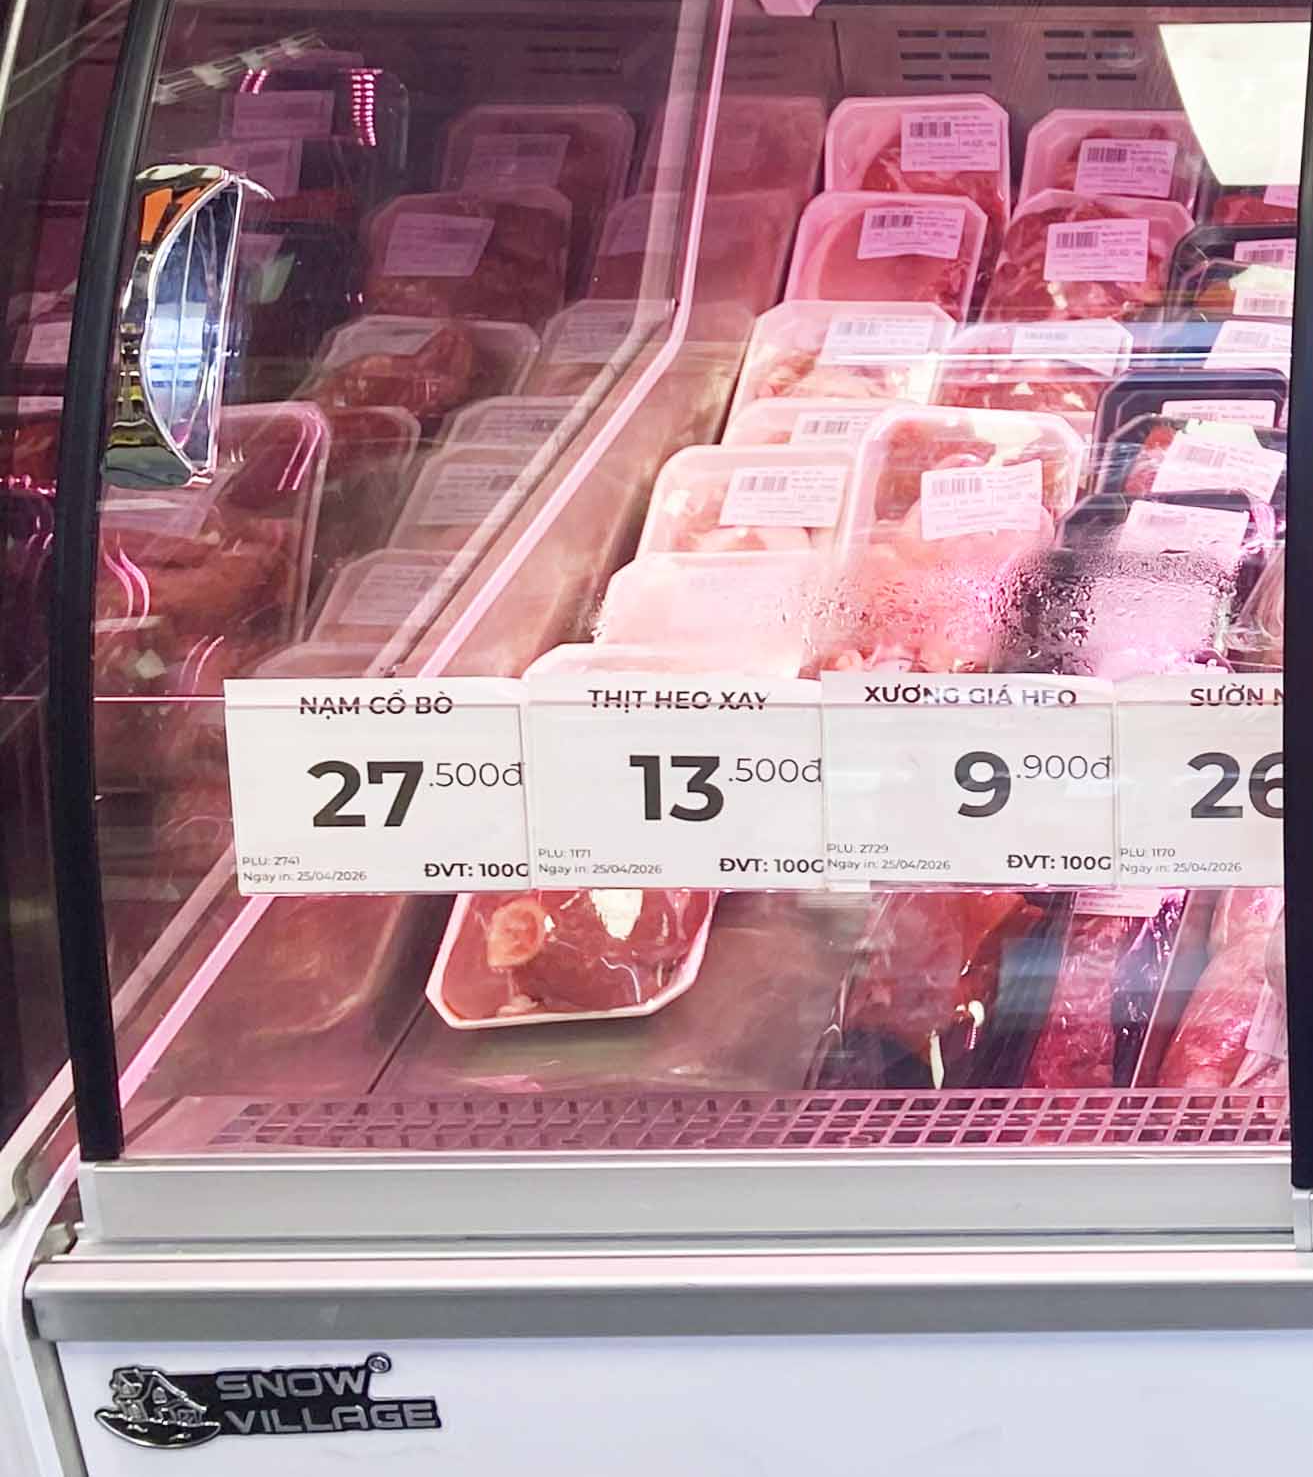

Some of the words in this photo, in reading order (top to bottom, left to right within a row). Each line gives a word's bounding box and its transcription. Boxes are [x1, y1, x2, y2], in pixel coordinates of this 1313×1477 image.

[299, 696, 360, 721] NẠM
[415, 691, 454, 715] BÒ
[588, 690, 648, 714] THỊT
[655, 691, 712, 710] HEO
[718, 691, 770, 710] XAY
[864, 683, 960, 705] XƯƠNG
[296, 870, 368, 883] 25/04/2026
[424, 862, 474, 879] ĐVT:
[215, 1370, 366, 1401] SNOW
[224, 1401, 436, 1434] VILLAGE
